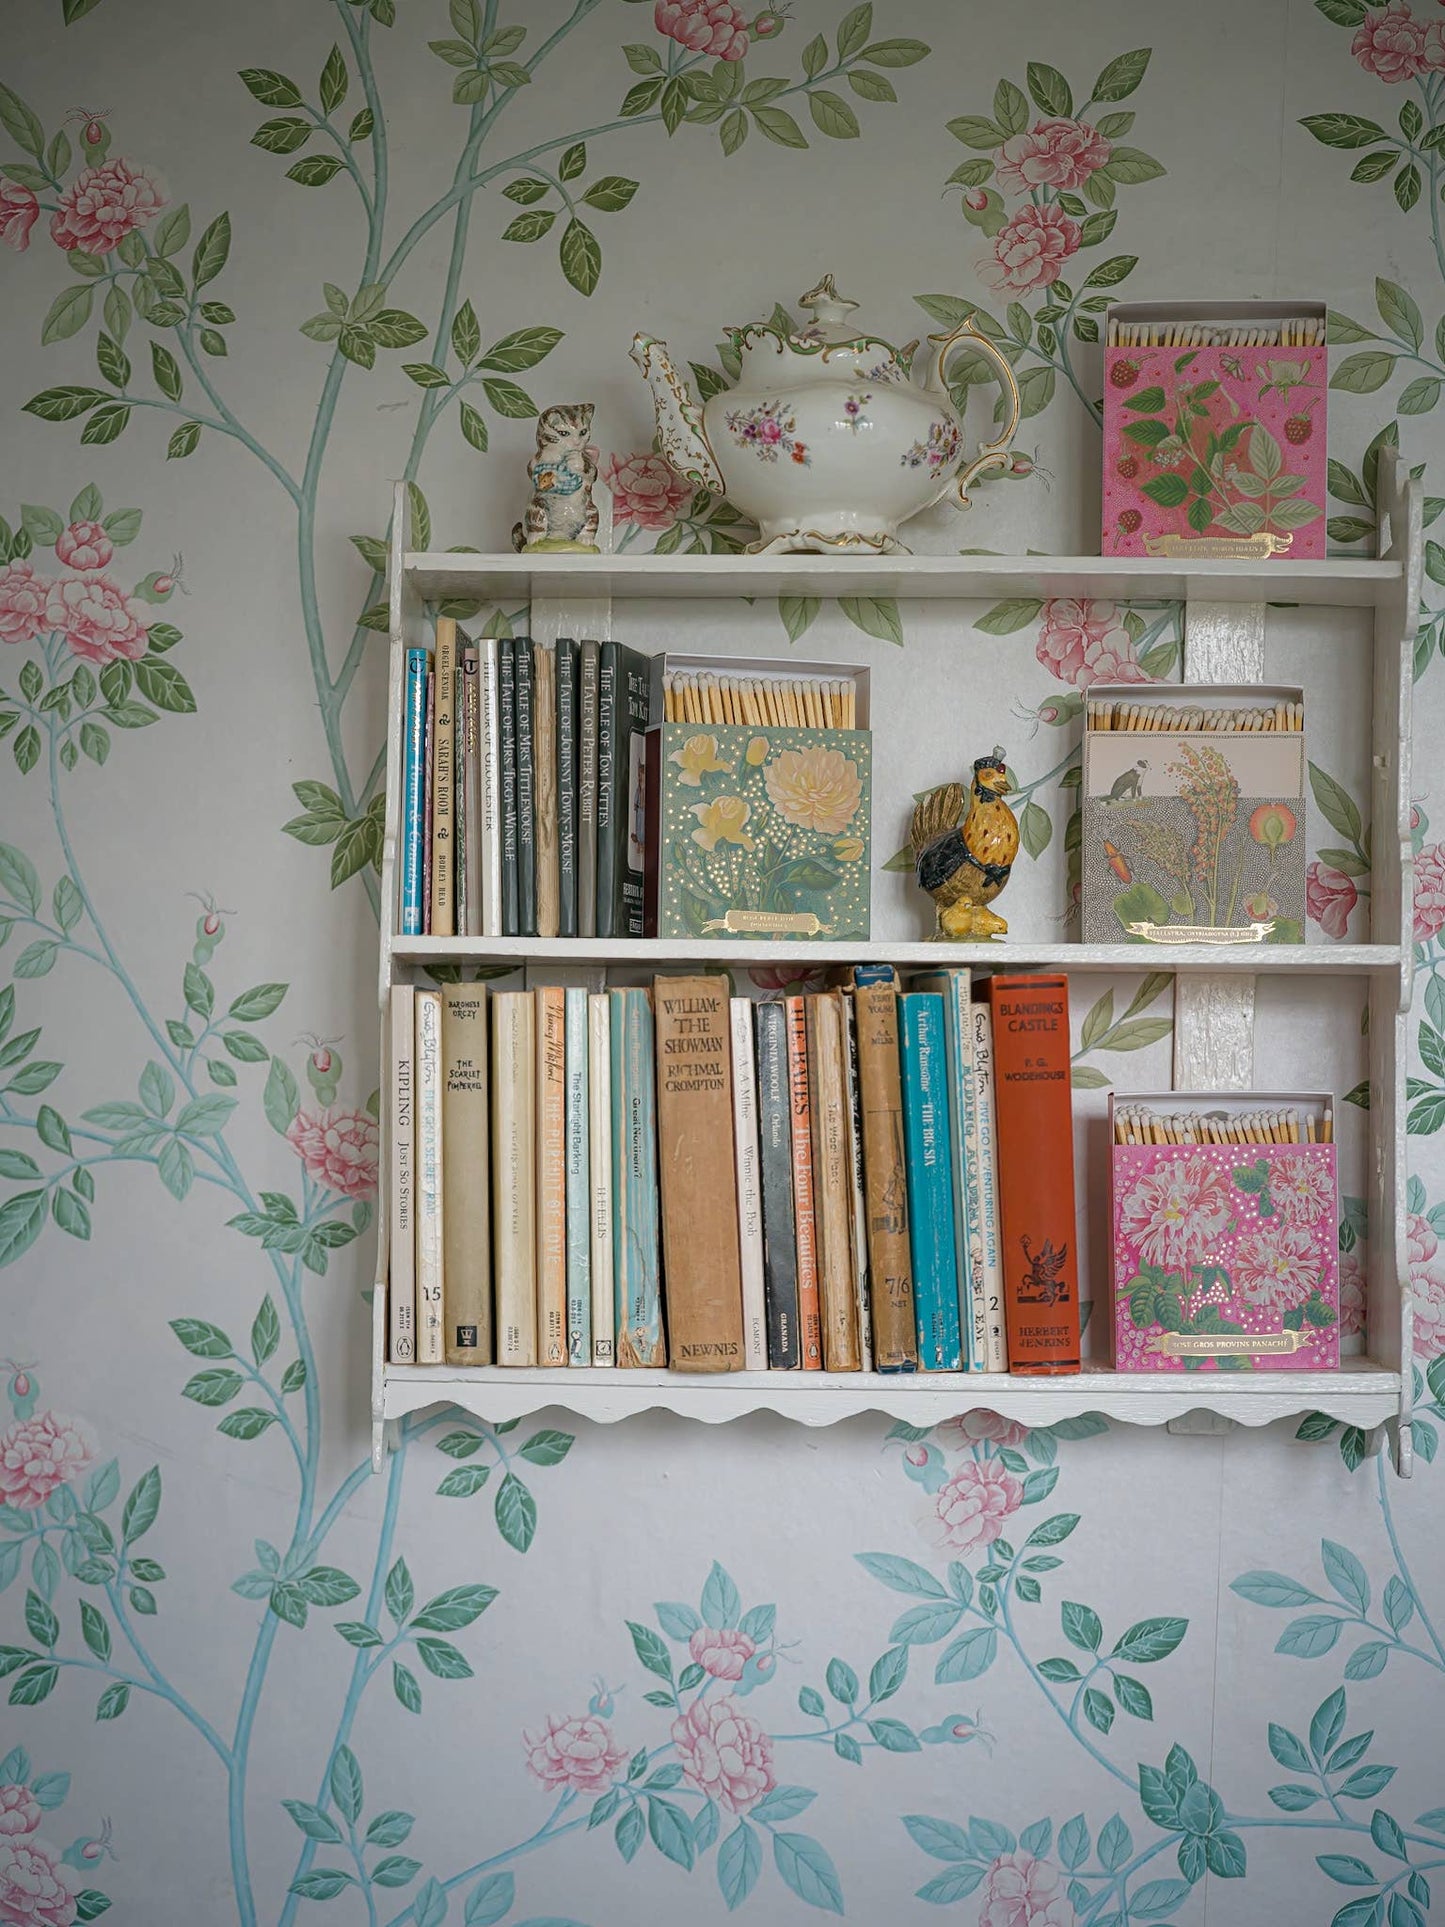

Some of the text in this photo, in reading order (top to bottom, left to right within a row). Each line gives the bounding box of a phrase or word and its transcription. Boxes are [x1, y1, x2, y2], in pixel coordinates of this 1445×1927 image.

[441, 645, 449, 700] ORGEL-SENDAK
[502, 652, 514, 677] THE
[519, 651, 530, 676] THE
[561, 653, 573, 677] THE
[485, 687, 495, 729] TAILOR
[502, 680, 515, 712] TALE
[519, 679, 531, 711] TALE
[561, 683, 572, 713] TALE
[504, 716, 514, 732] OF
[520, 714, 530, 731] OF
[561, 716, 571, 731] OF
[580, 654, 596, 824] THE TALE OF PETER RABBIT
[599, 666, 613, 827] THE TALE OF TOM KITTEN
[561, 735, 573, 784] JOHNNY
[410, 763, 422, 804] Town
[437, 739, 449, 815] SARAH'S ROOM
[485, 752, 496, 831] GLOUCESTER
[410, 810, 421, 822] &
[521, 765, 533, 844] TITTLEMOUSE
[406, 831, 420, 895] Country
[438, 855, 446, 906] BODLEY HEAD
[452, 1010, 477, 1019] ORCZY
[1000, 1002, 1063, 1016] BLANDINGS
[673, 1018, 710, 1033] THE
[1008, 1019, 1058, 1032] CASTLE
[544, 1005, 563, 1083] Nancy Mitford
[665, 1037, 723, 1054] SHOWMAN
[917, 1010, 931, 1092] Arthur Ransome
[973, 1014, 990, 1095] Enid Blyton
[420, 1037, 438, 1084] Blyton
[449, 1069, 481, 1080] SCARLET
[457, 1060, 473, 1070] THE
[667, 1062, 723, 1077] RICHMAL
[1004, 1070, 1065, 1081] WODEHOUSE
[665, 1078, 724, 1092] CROMPTON
[738, 1058, 751, 1119] A. A. Milne
[768, 1014, 781, 1147] VIRGINIA WOOLF Orlando
[793, 1052, 808, 1115] BATES
[571, 1072, 581, 1174] The Starlight Barking
[633, 1098, 641, 1126] Great
[980, 1101, 989, 1123] FIVE
[398, 1060, 410, 1229] KIPLING JUST SO STORIES
[795, 1126, 810, 1160] The
[922, 1102, 936, 1167] THE BIG SIX
[981, 1127, 990, 1145] GO
[546, 1095, 561, 1264] THE PURSUIT OF LOVE
[796, 1165, 813, 1205] Four
[966, 1146, 980, 1236] ACADEMY
[426, 1187, 436, 1217] RAIL
[598, 1209, 607, 1239] ELLIS
[798, 1210, 814, 1289] Beauties
[985, 1231, 996, 1268] AGAIN
[423, 1287, 441, 1301] 15
[989, 1297, 999, 1311] 2
[752, 1318, 761, 1355] EGMONT
[1019, 1326, 1069, 1336] HERBERT
[1019, 1337, 1071, 1348] JENKINS
[680, 1342, 738, 1357] NEWNES
